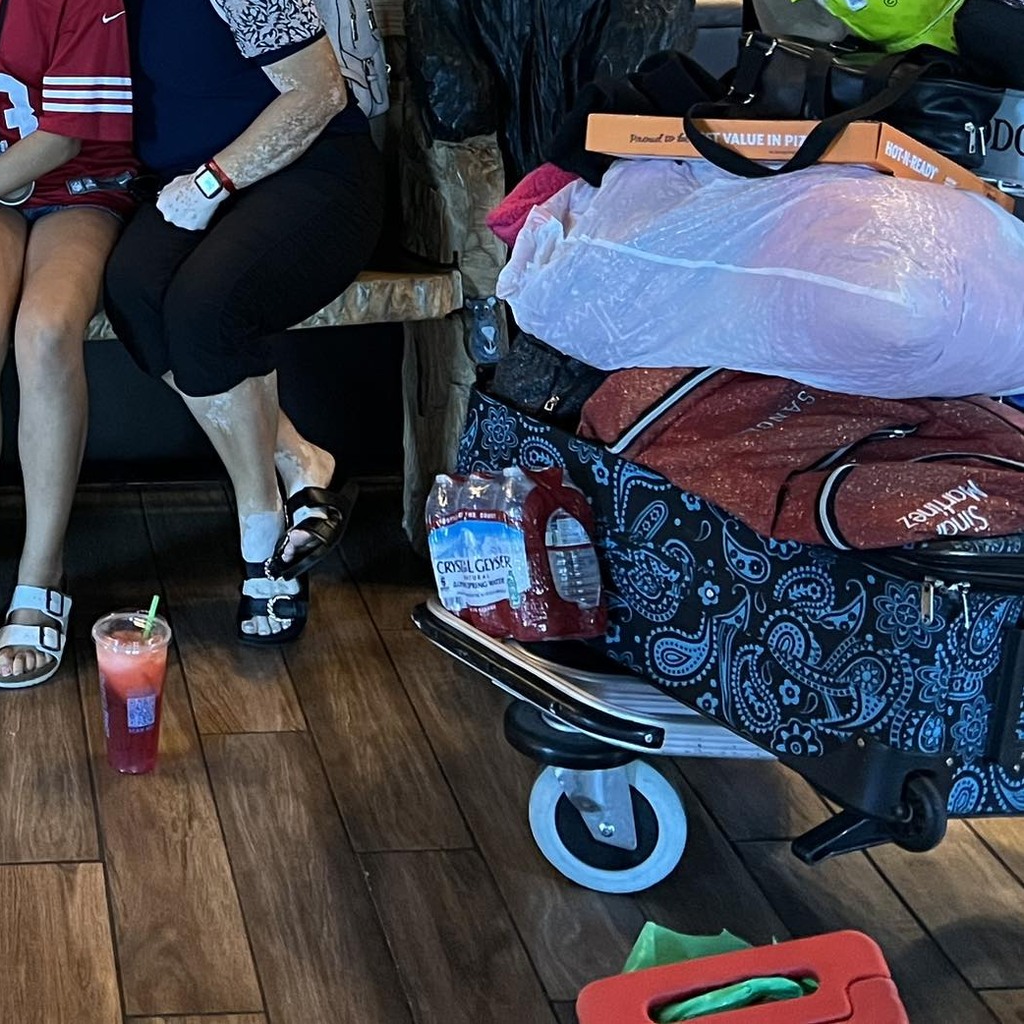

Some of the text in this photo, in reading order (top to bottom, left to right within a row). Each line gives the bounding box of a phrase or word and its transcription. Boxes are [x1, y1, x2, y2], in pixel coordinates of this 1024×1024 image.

[722, 132, 765, 147] VALUE
[767, 133, 782, 147] IN
[784, 134, 808, 147] PIZ
[884, 140, 940, 180] HOT-N-READY
[896, 479, 989, 529] Martinez
